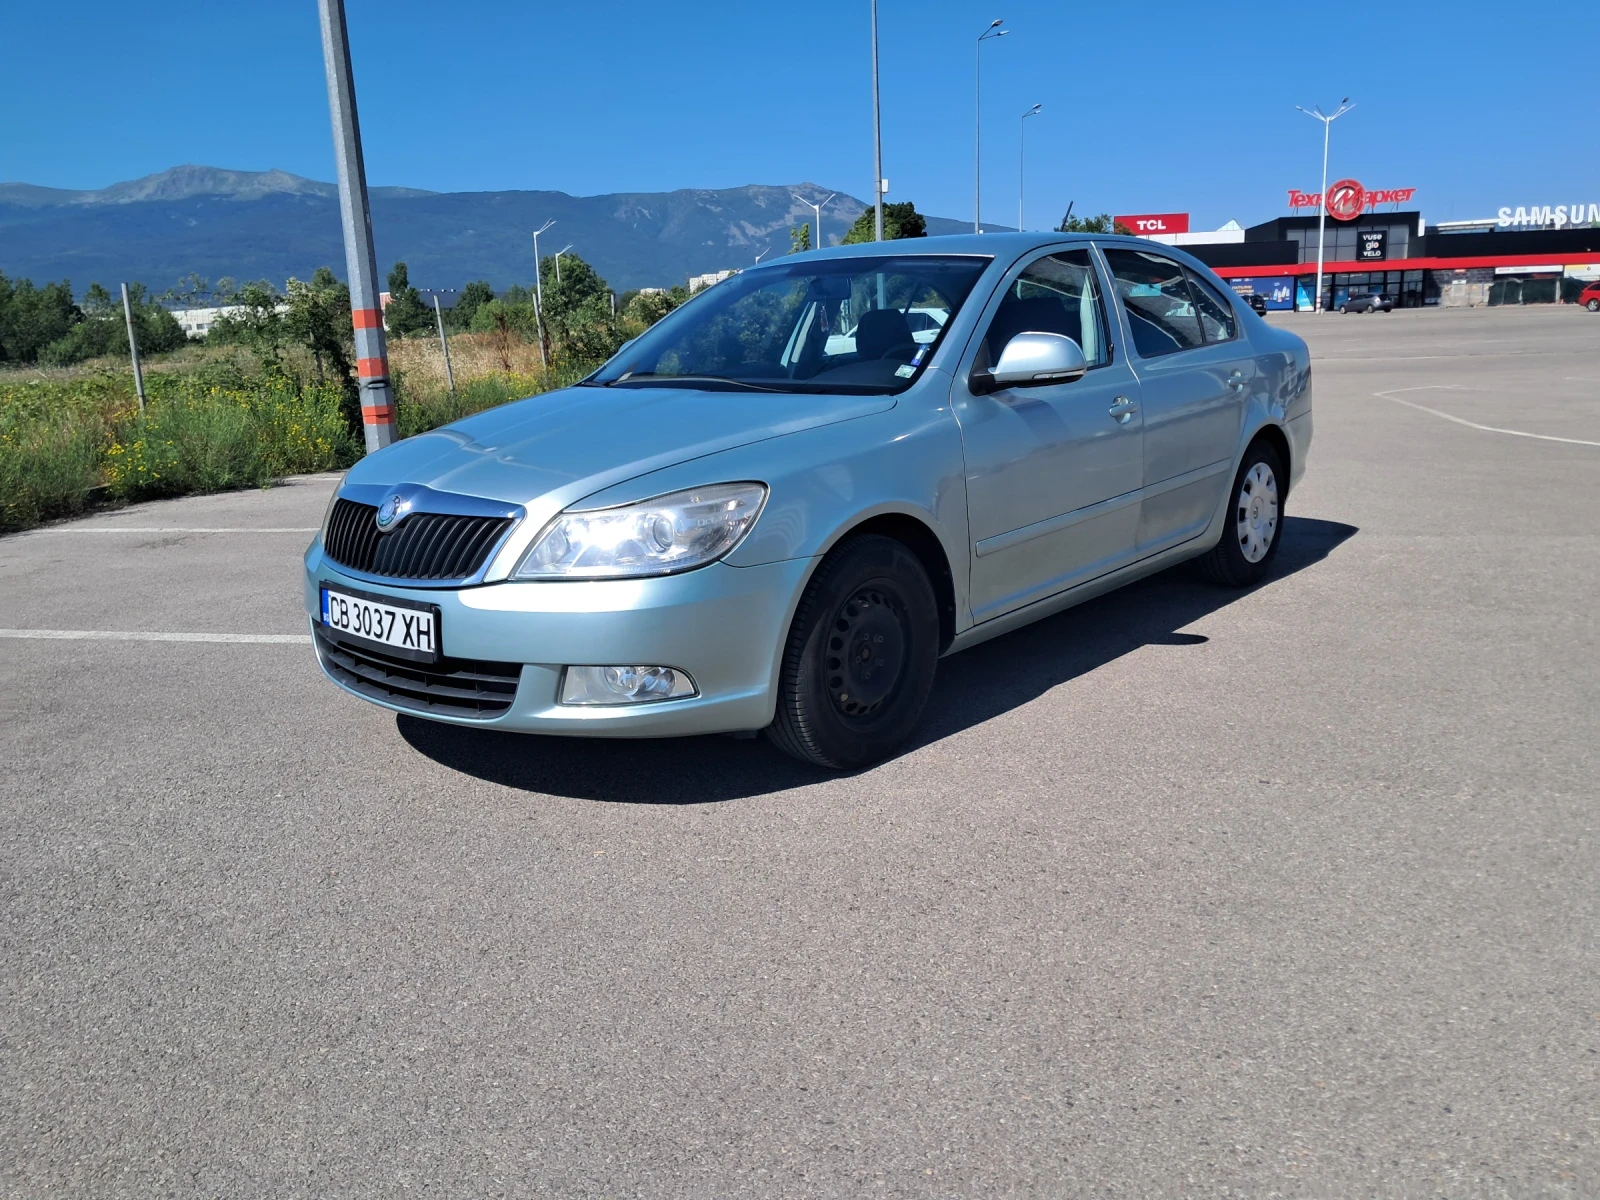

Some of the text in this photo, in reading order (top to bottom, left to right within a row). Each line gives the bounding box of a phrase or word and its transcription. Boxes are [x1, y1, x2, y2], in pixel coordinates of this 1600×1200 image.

[1136, 219, 1166, 231] TCL
[1365, 240, 1379, 251] glo
[330, 596, 432, 650] CB 3037 XH
